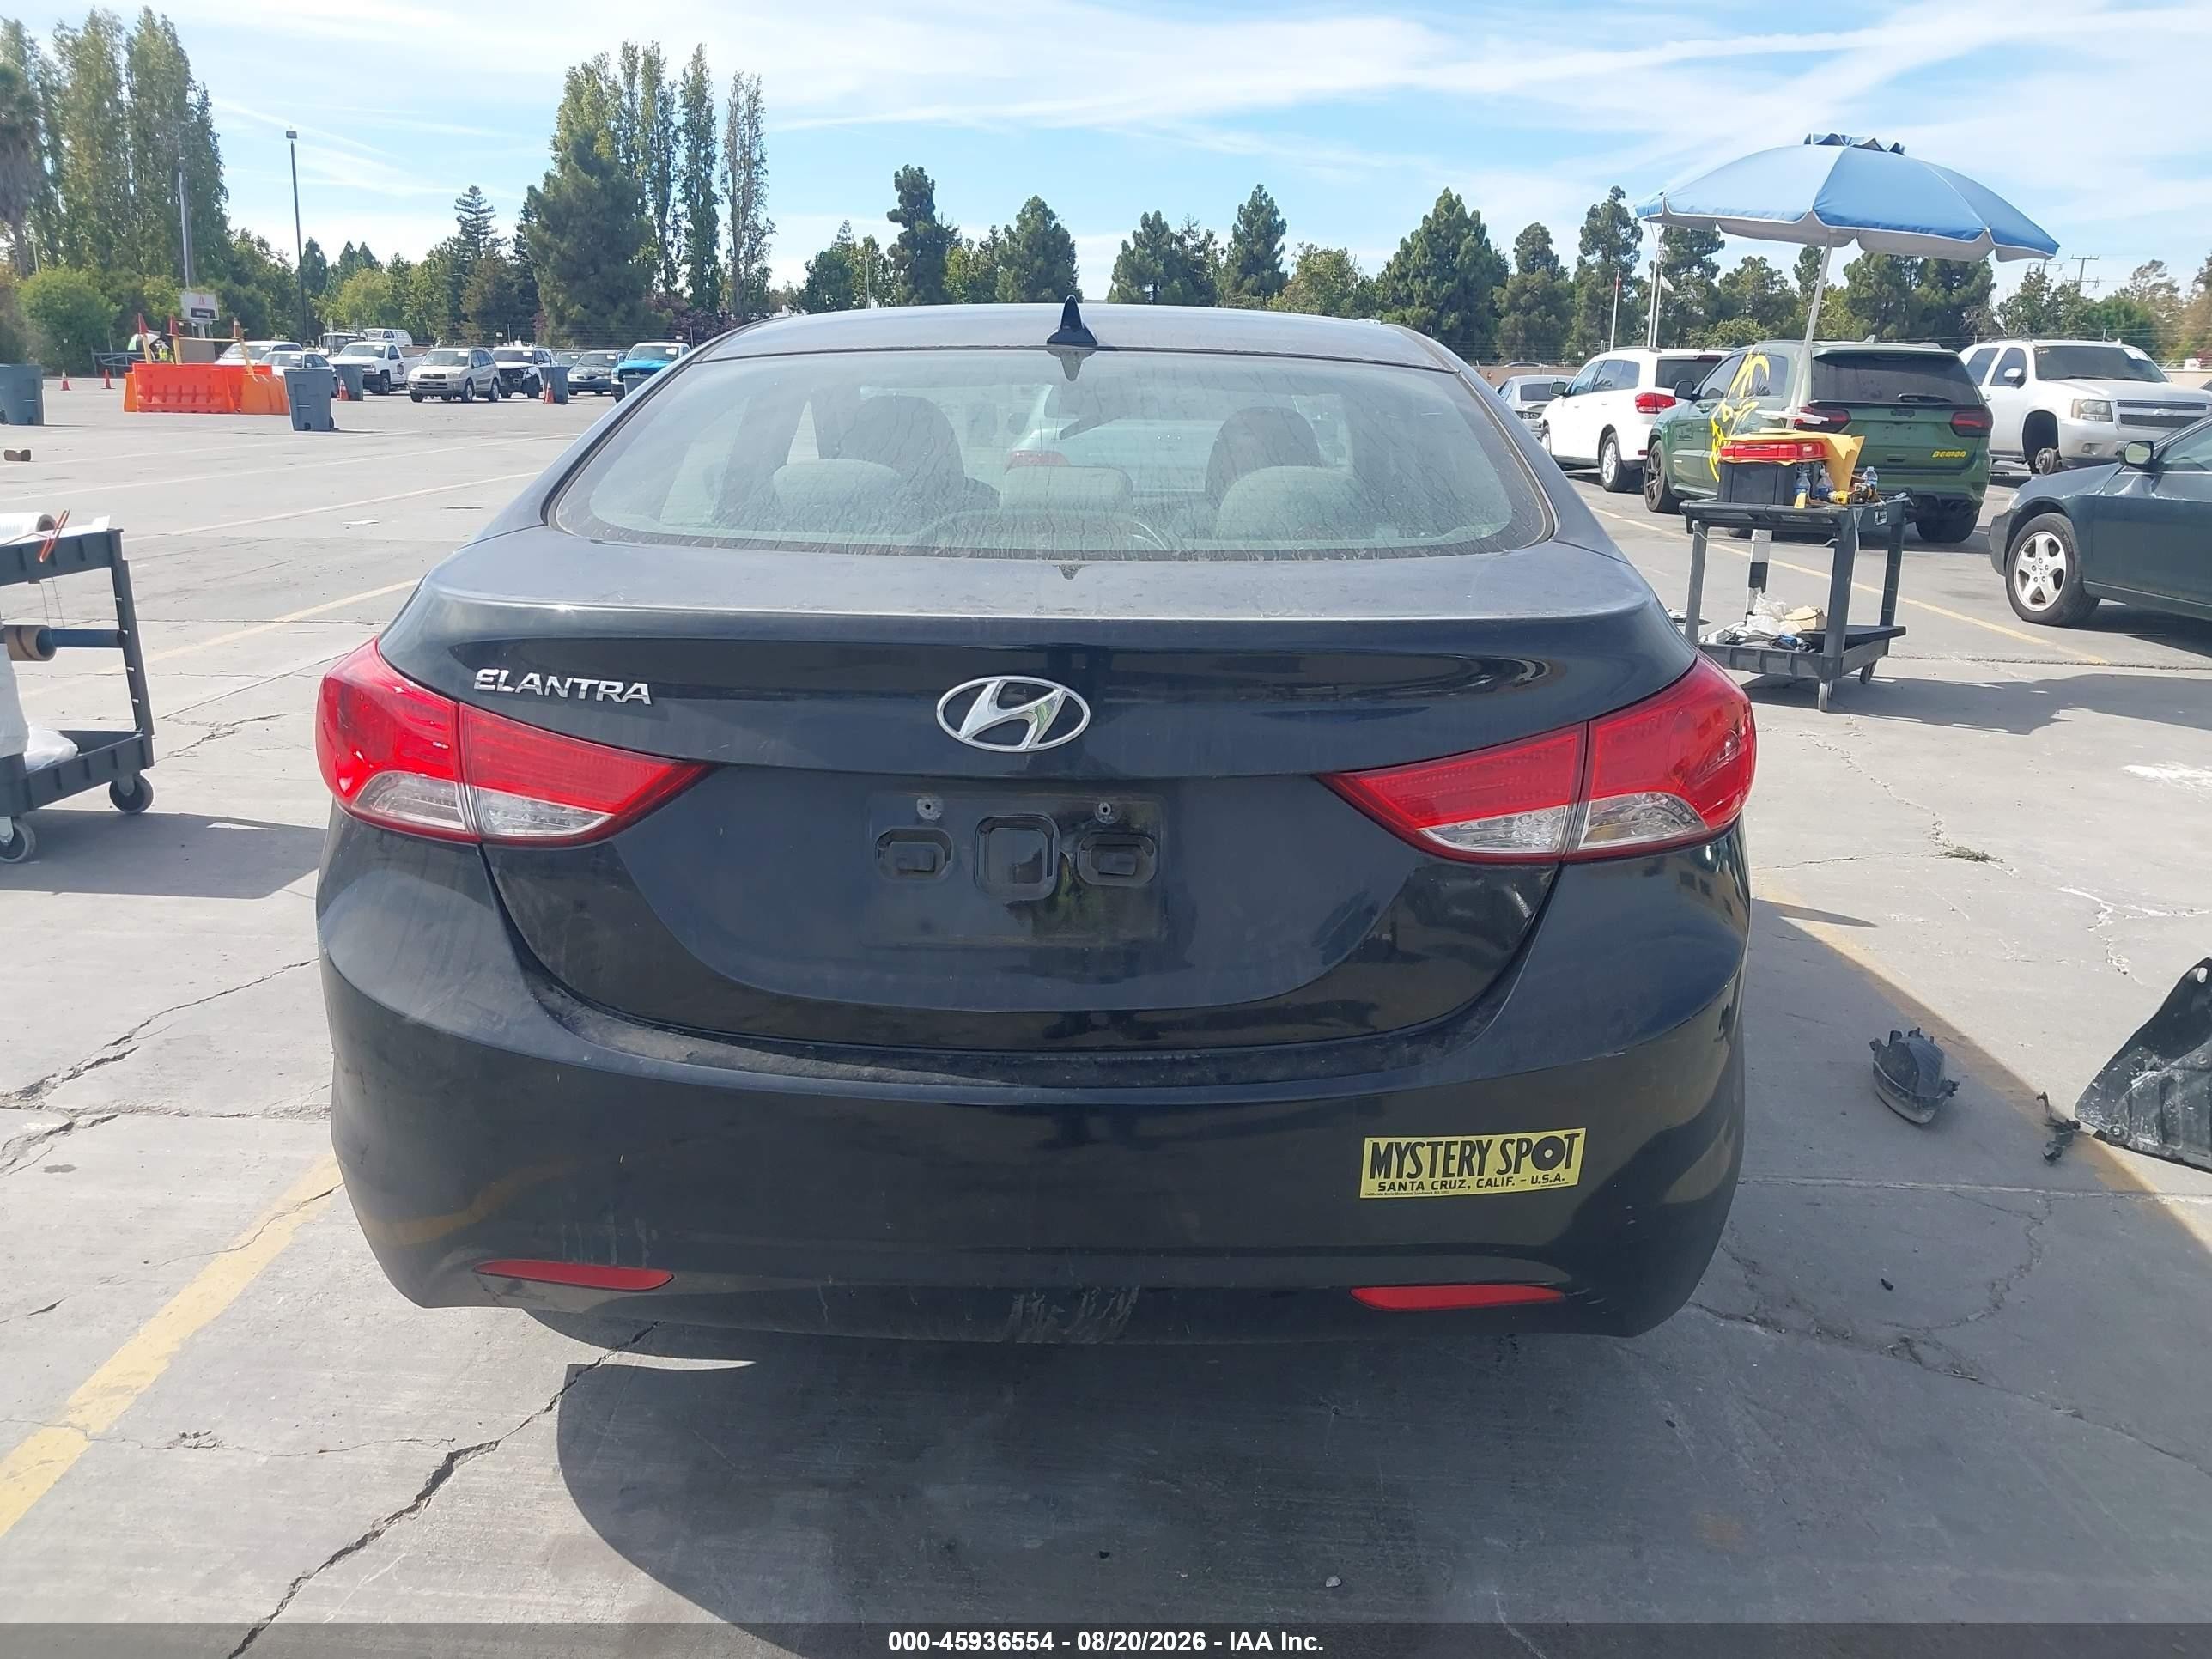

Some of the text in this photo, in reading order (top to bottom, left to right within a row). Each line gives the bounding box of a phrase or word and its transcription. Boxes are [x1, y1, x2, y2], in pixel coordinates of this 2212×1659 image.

[473, 668, 652, 705] ELANTRA
[1369, 1133, 1581, 1180] MYSTERY SPOT
[1377, 1180, 1425, 1192] SANTA
[1431, 1178, 1472, 1191] CRUZ,
[1475, 1176, 1516, 1188] CALIF.
[1530, 1173, 1565, 1185] U.S.A.
